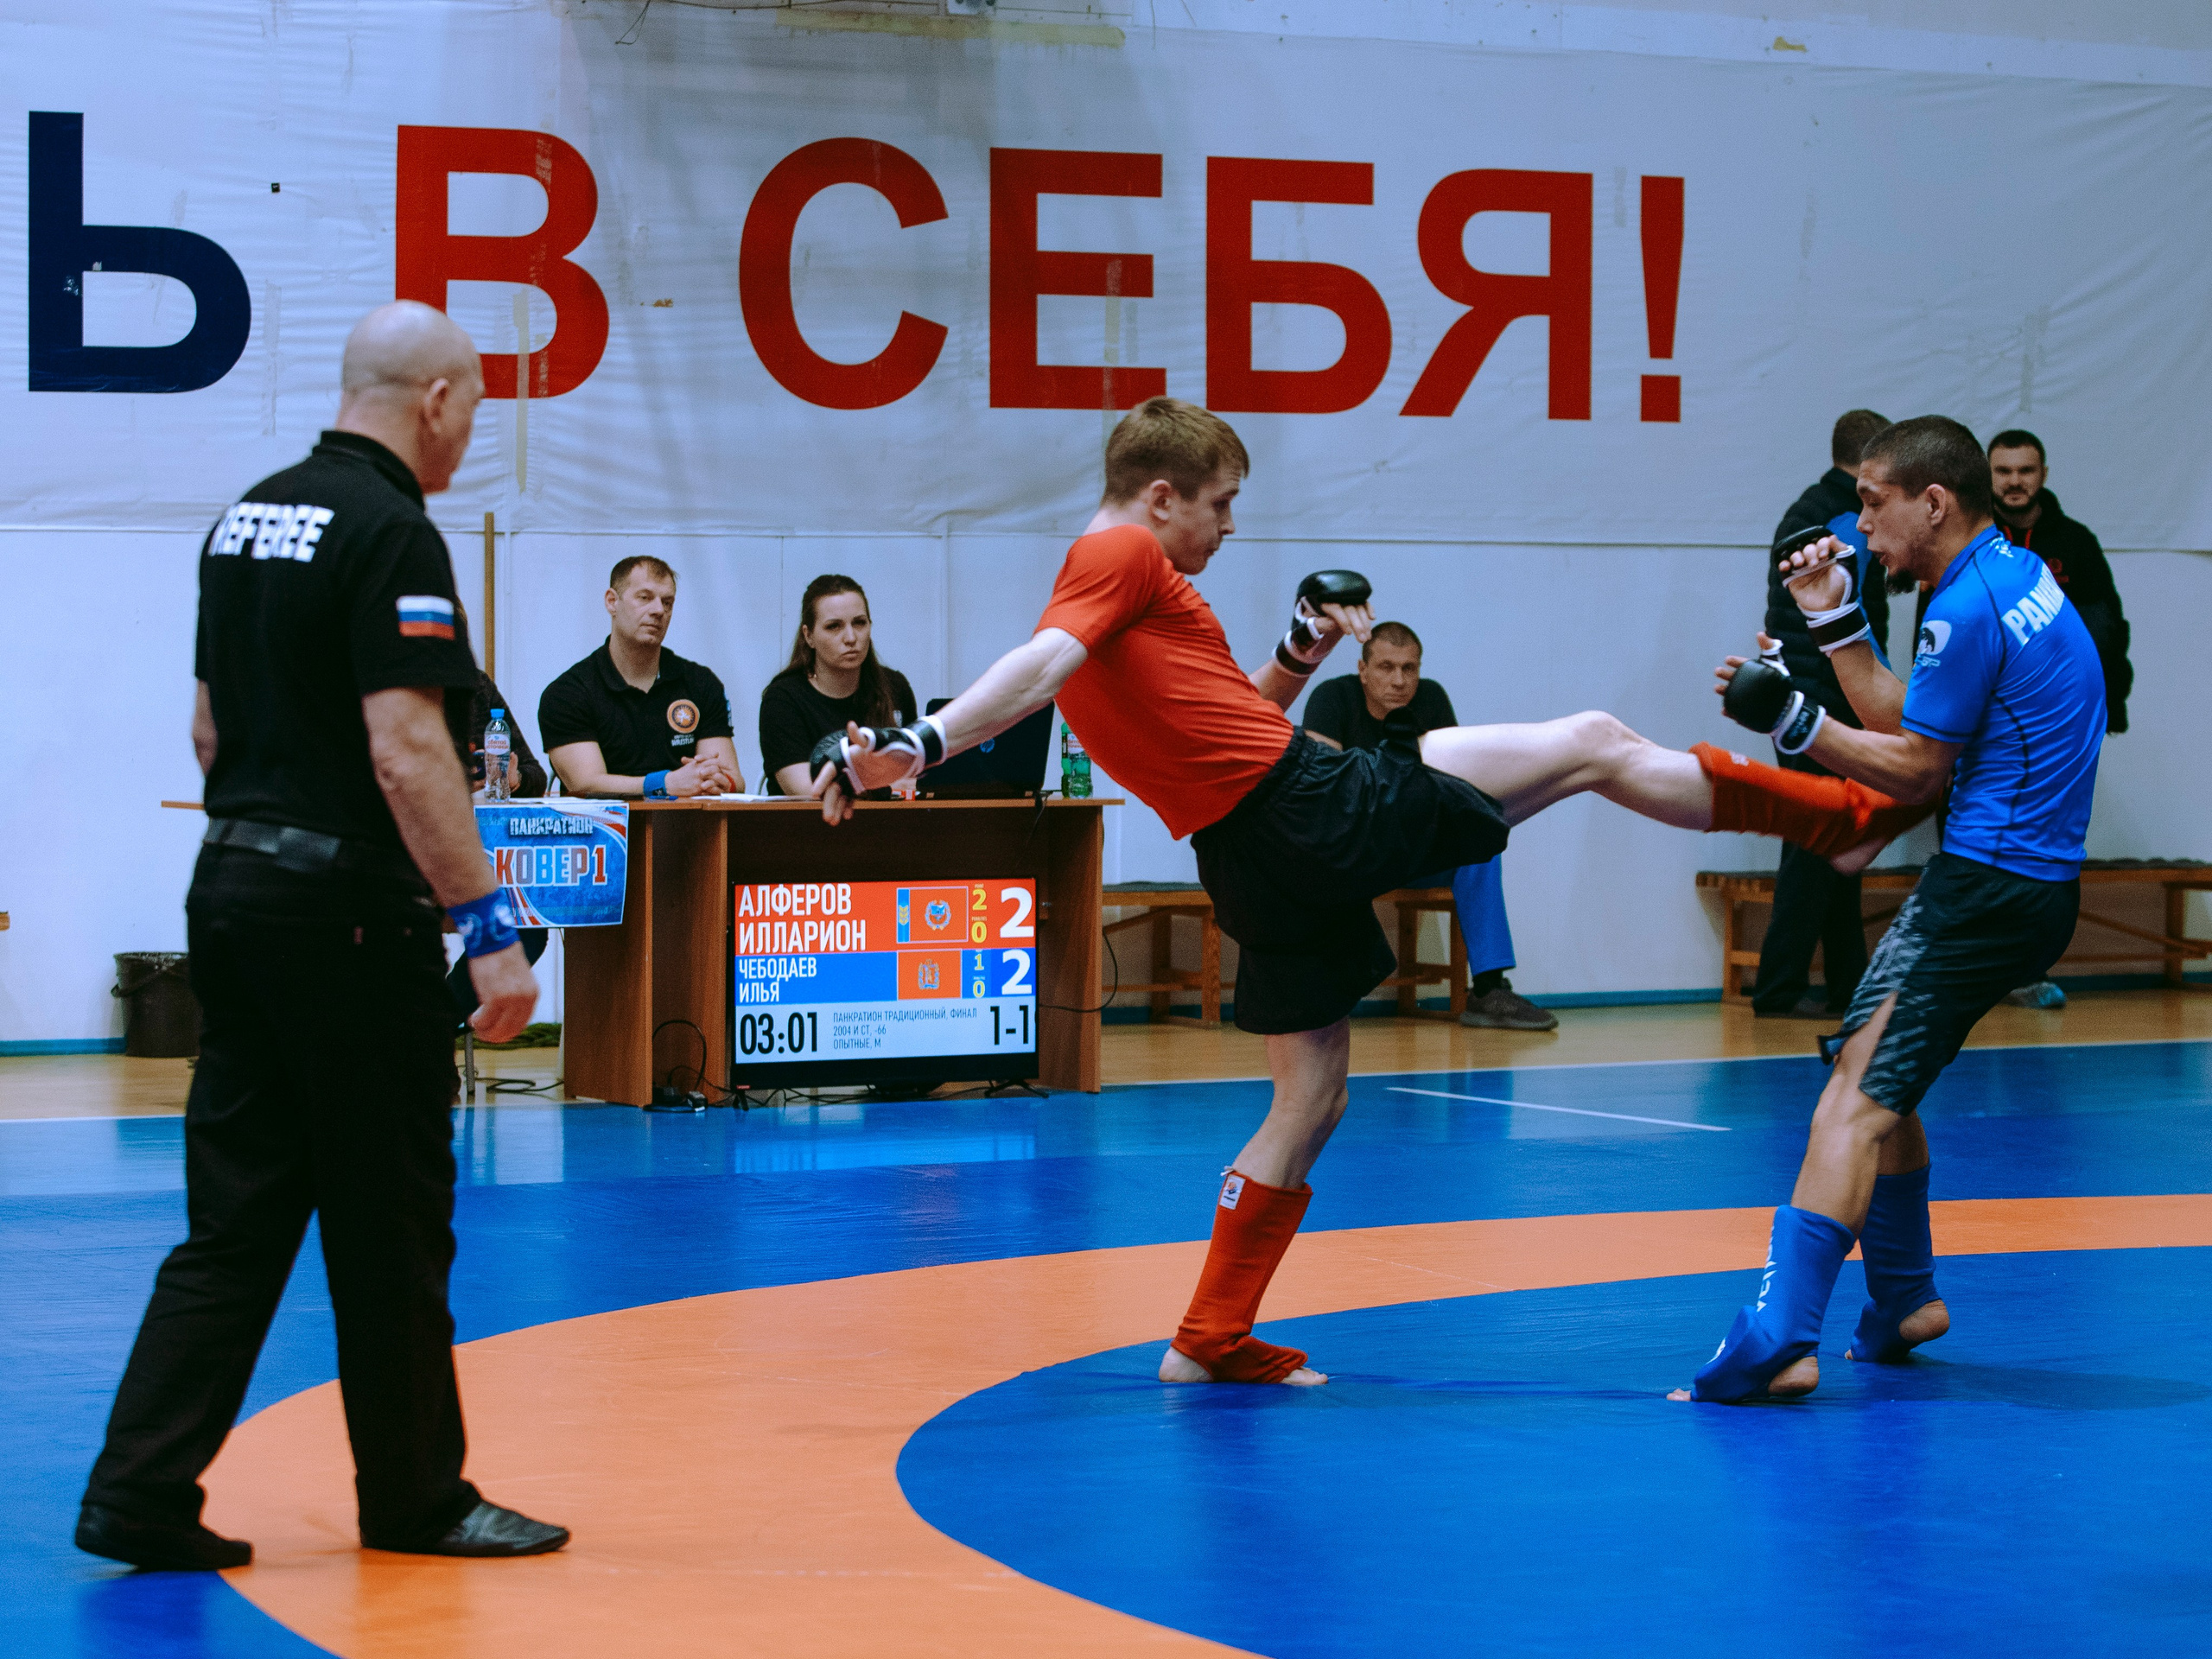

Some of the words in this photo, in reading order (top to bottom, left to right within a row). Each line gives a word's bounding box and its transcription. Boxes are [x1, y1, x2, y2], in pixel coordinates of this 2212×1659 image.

[29, 111, 251, 393] Ь
[395, 124, 609, 399] В
[740, 137, 1684, 423] СЕБЯ!
[510, 817, 594, 836] ПАНКРАТИОН
[738, 883, 852, 918] АЛФЕРОВ
[972, 888, 987, 911] 2
[1000, 887, 1034, 938] 2
[739, 919, 867, 954] ИЛЛАРИОН
[971, 921, 987, 944] 0
[739, 957, 817, 981] ЧЕБОДАЕВ
[974, 953, 985, 970] 1
[1001, 949, 1033, 995] 2
[739, 982, 780, 1003] ИЛЬЯ
[973, 980, 985, 998] 0
[833, 1011, 882, 1023] ПАНКРАТИОН
[885, 1007, 948, 1022] ТРАДИЦИОННЫЙ,
[950, 1007, 977, 1019] ФИНАЛ
[990, 1004, 1030, 1046] 1-1
[740, 1011, 818, 1055] 03:01
[833, 1026, 851, 1036] 2004
[853, 1025, 859, 1035] И
[861, 1024, 872, 1036] СТ,
[874, 1024, 887, 1035] -66
[833, 1039, 873, 1050] ОПЫТНЫЕ,
[874, 1038, 881, 1048] М
